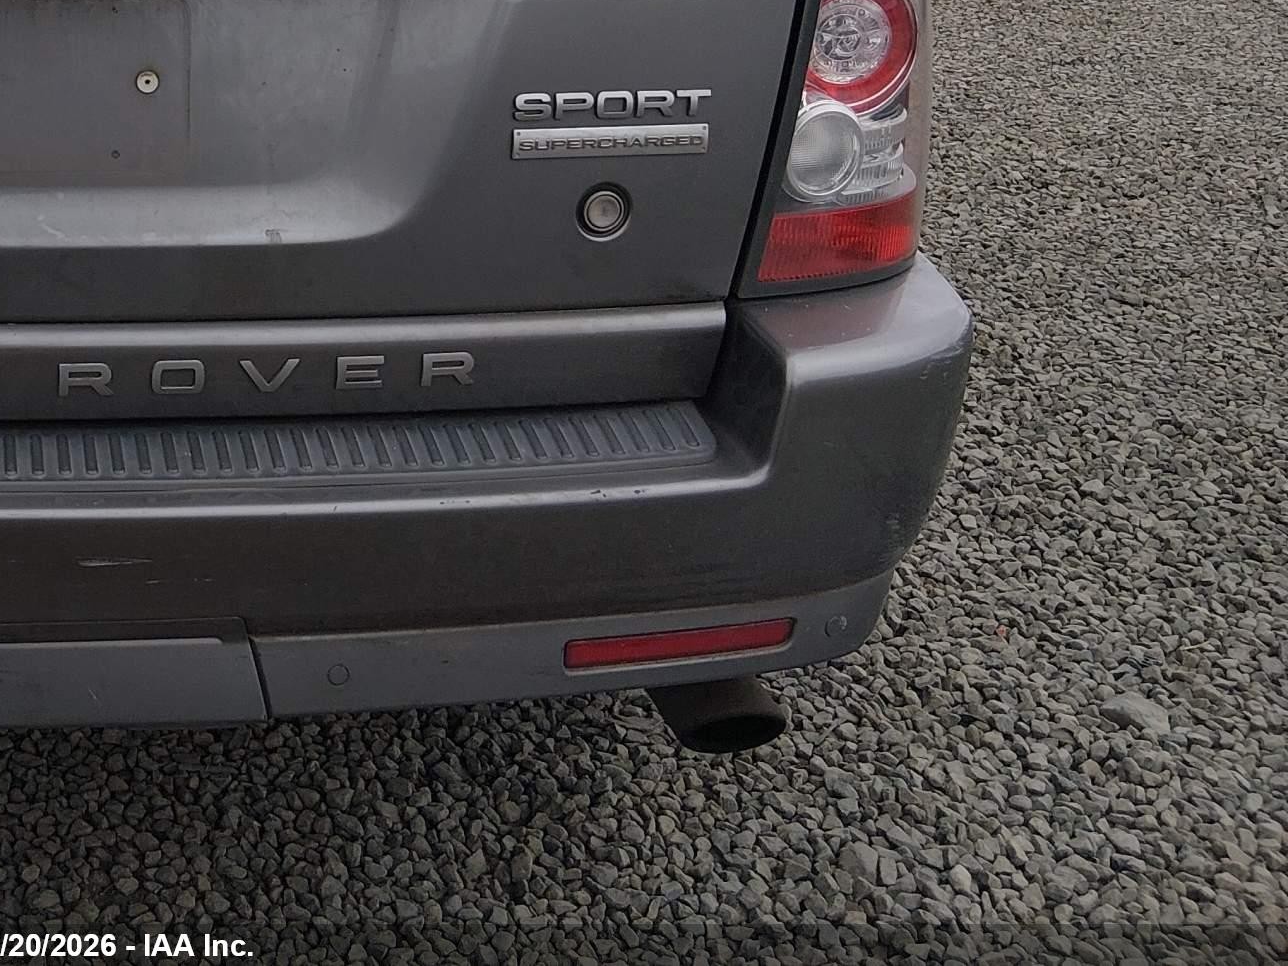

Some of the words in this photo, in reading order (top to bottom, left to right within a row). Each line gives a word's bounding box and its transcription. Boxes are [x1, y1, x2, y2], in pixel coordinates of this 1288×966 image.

[513, 89, 712, 121] SPORT
[518, 134, 705, 152] SUPERCHARGED
[57, 350, 475, 397] ROVER
